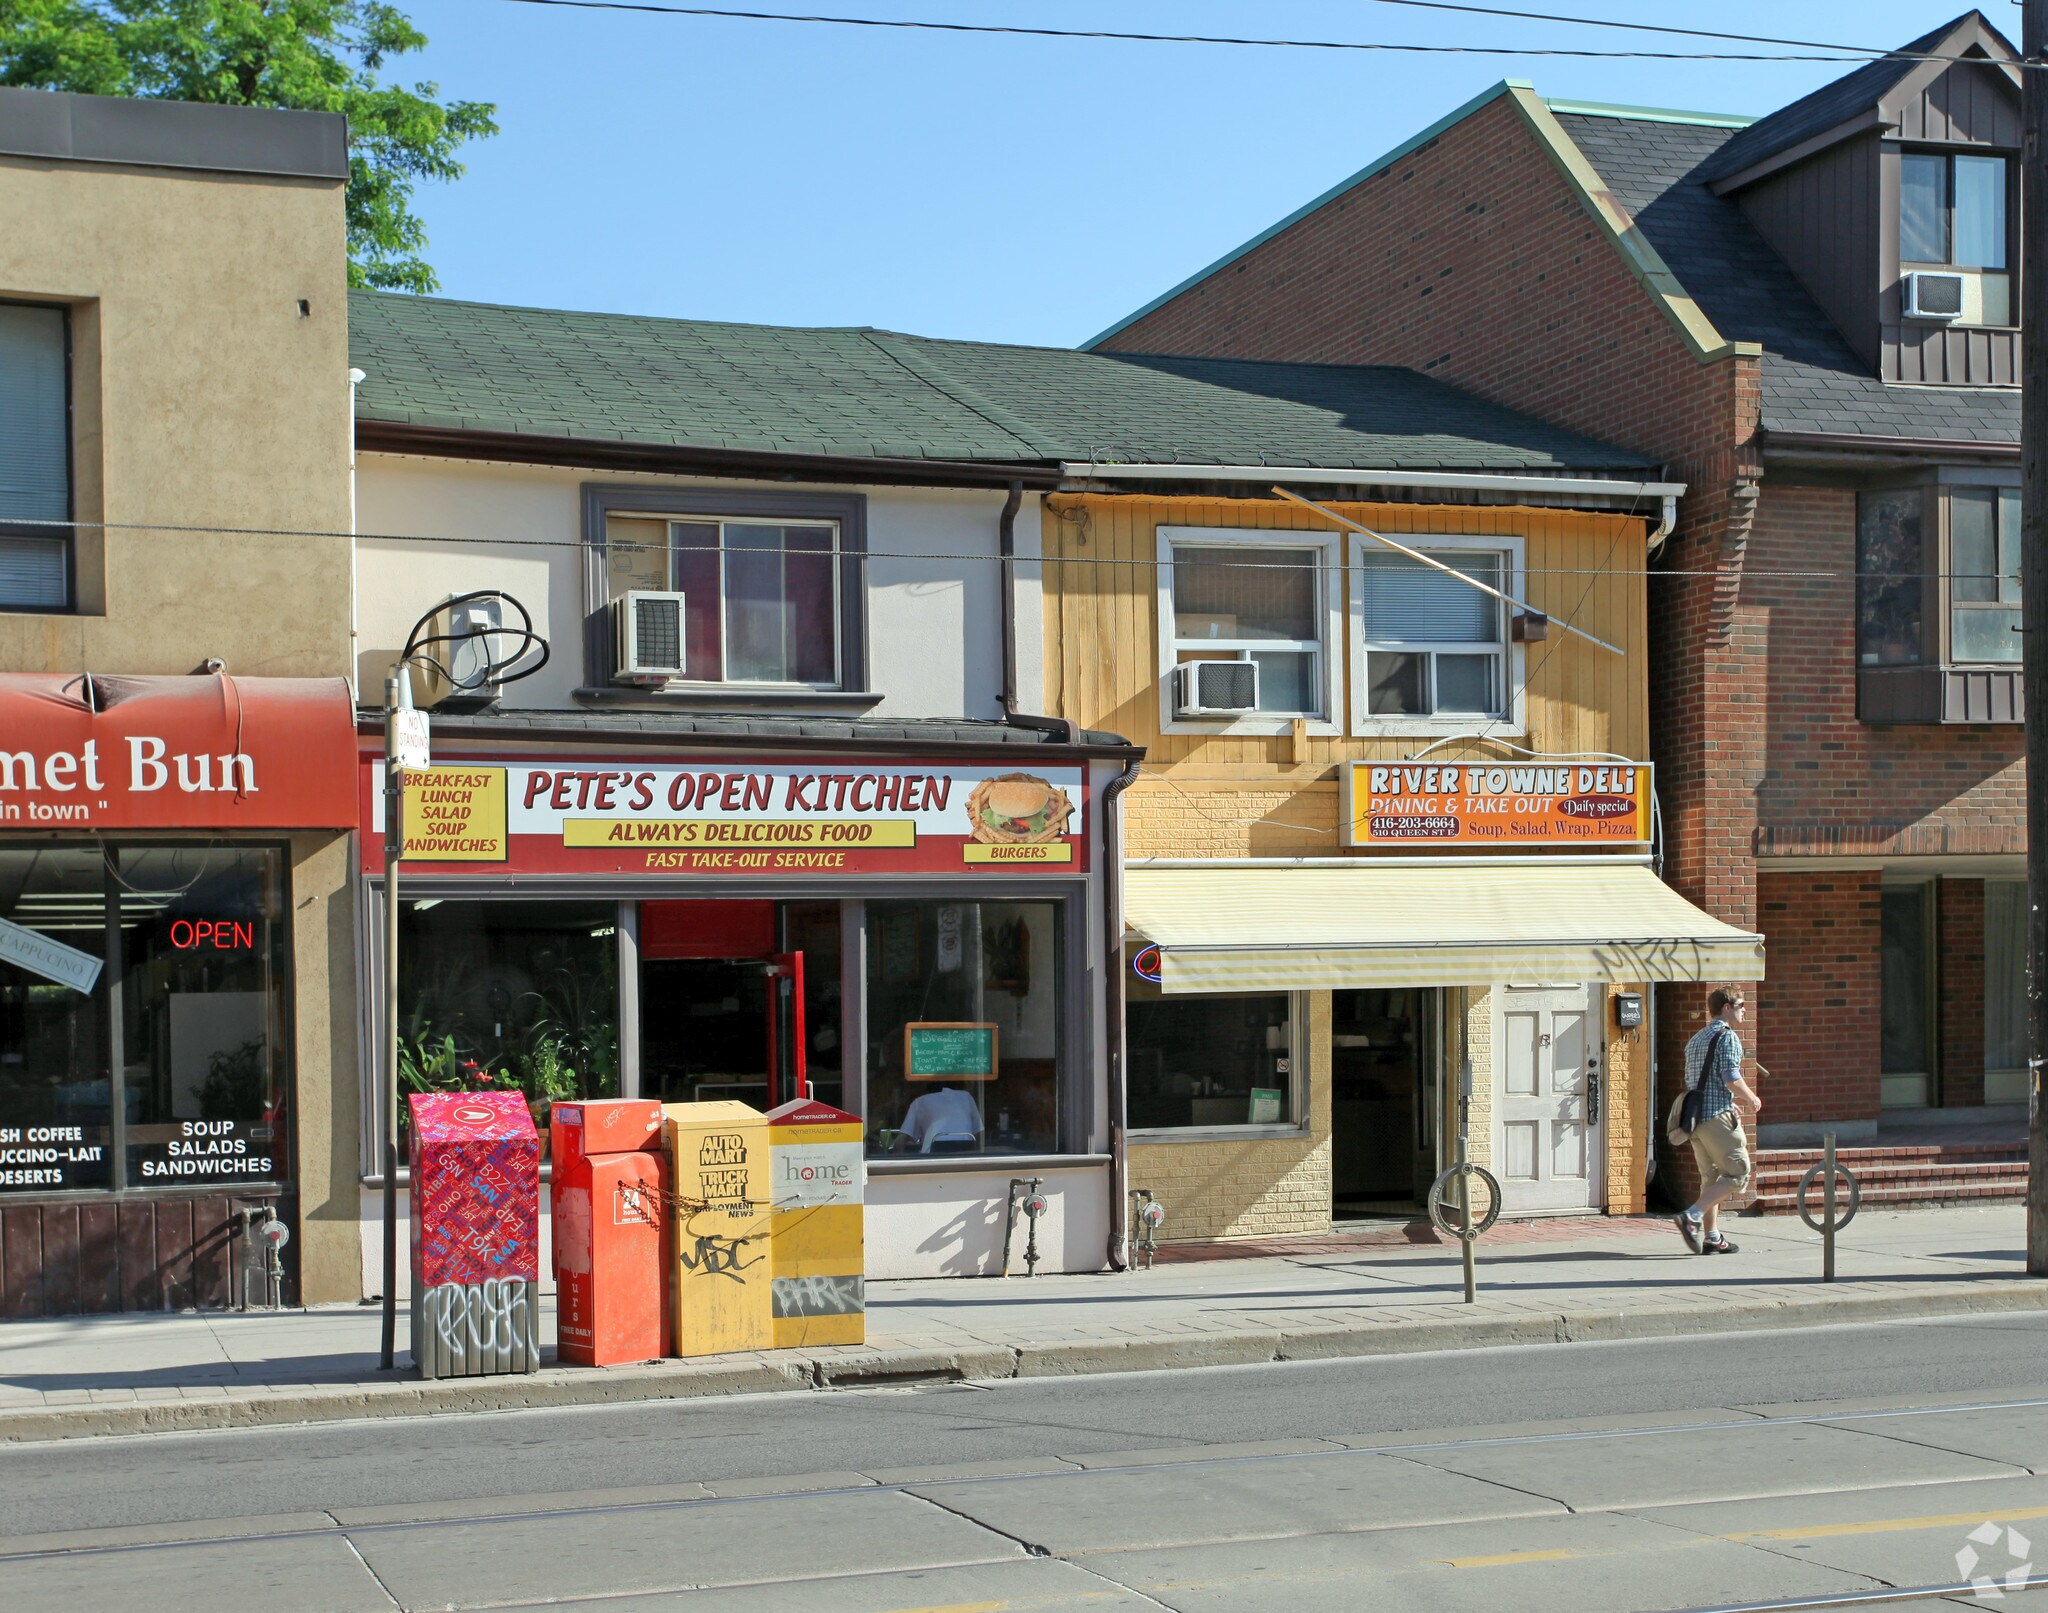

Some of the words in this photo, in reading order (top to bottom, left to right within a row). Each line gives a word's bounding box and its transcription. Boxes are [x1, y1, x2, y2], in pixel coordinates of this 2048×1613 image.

[409, 716, 419, 730] NO
[125, 736, 260, 791] Bun
[403, 774, 492, 788] BREAKFAST
[1468, 767, 1571, 795] TOWNE
[420, 790, 473, 804] LUNCH
[523, 771, 656, 811] PETE'S
[667, 772, 774, 812] OPEN
[784, 774, 952, 813] KITCHEN
[28, 803, 89, 820] town
[421, 806, 472, 820] SALAD
[1370, 797, 1438, 814] DINING
[1445, 798, 1459, 814] &
[1464, 797, 1510, 814] TAKE
[1514, 797, 1554, 814] OUT
[1563, 800, 1596, 817] Daily
[1597, 799, 1629, 817] special
[426, 822, 468, 836] SOUP
[1372, 817, 1456, 829] 416-203-6664
[1468, 821, 1508, 838] Soup,
[1510, 821, 1552, 836] Salad,
[1555, 821, 1595, 838] Wrap,
[1597, 821, 1637, 836] Pizza,
[608, 823, 698, 842] ALWAYS
[704, 823, 814, 842] DELICIOUS
[819, 823, 873, 842] FOOD
[1372, 829, 1389, 837] 510
[1390, 829, 1430, 838] QUEEN
[1431, 829, 1446, 837] ST
[403, 838, 498, 852] ANDWICHES
[990, 846, 1048, 860] BURGERS
[646, 852, 689, 868] FAST
[691, 852, 771, 868] TAKE-OUT
[774, 852, 846, 868] SERVICE
[170, 919, 253, 949] OPEN
[0, 933, 84, 977] CAPPUCINO
[28, 1126, 82, 1142] COFFEE
[182, 1120, 235, 1137] SOUP
[168, 1138, 247, 1157] SALADS
[702, 1134, 744, 1151] AUTO
[700, 1147, 747, 1166] MART
[142, 1158, 273, 1177] SANDWICHES
[439, 1154, 464, 1178] G5N
[480, 1163, 511, 1192] B2Z
[699, 1169, 749, 1185] TRUCK
[469, 1176, 499, 1203] S4N
[702, 1183, 746, 1199] MART
[728, 1210, 754, 1219] NEWS
[462, 1225, 497, 1262] T9K
[491, 1239, 521, 1265] K4A
[560, 1325, 574, 1335] FREE
[575, 1328, 592, 1337] DAILY
